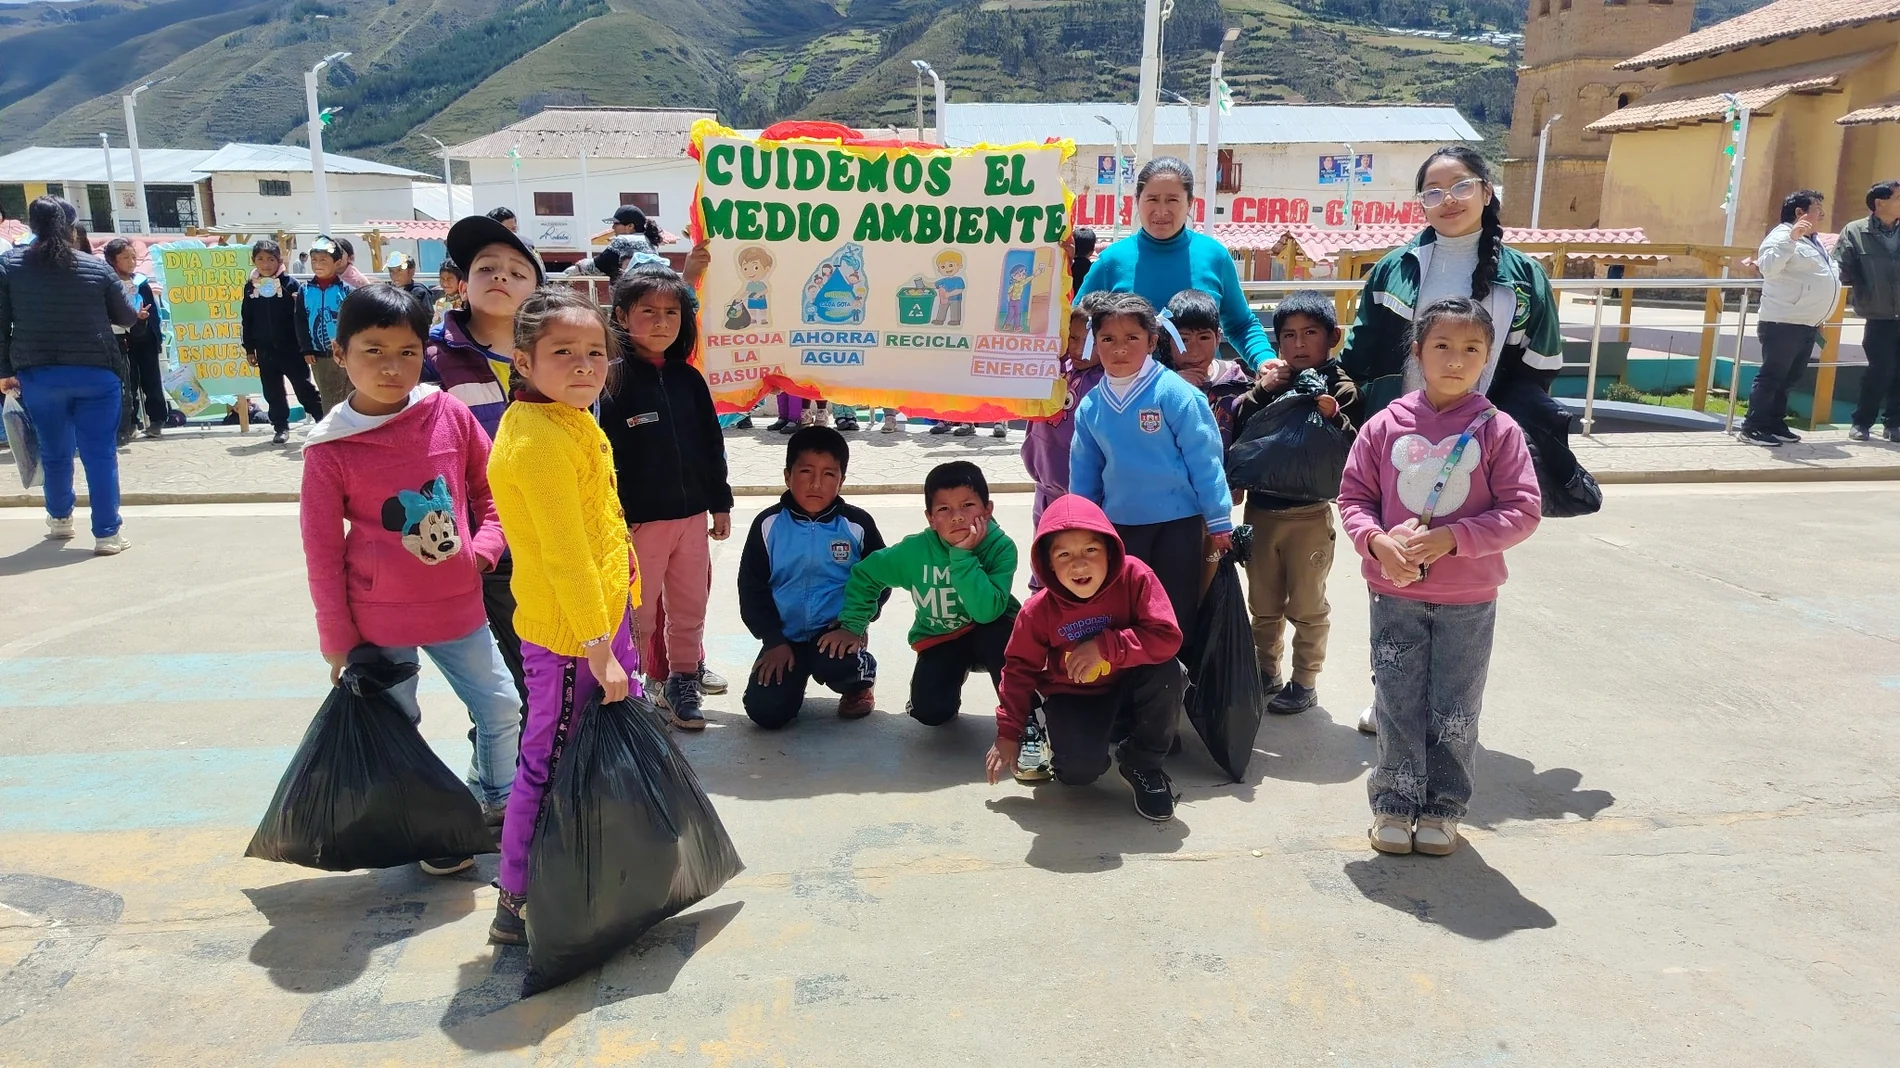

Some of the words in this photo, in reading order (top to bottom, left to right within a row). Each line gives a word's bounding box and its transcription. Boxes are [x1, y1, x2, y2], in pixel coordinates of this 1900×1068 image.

[705, 143, 951, 197] CUIDEMOS
[984, 153, 1035, 196] EL
[1232, 197, 1309, 223] CIRO
[701, 196, 840, 242] MEDIO
[852, 201, 1066, 244] AMBIENTE
[165, 251, 202, 270] DIA
[210, 250, 238, 269] DE
[184, 268, 248, 286] TIERR
[168, 285, 244, 304] CUIDEM
[208, 301, 238, 320] EL
[173, 323, 243, 342] PLANE
[707, 332, 784, 348] RECOJA
[791, 330, 877, 346] AHORRA
[885, 334, 971, 350] RECICLA
[976, 335, 1059, 353] AHORRA
[734, 350, 758, 363] LA
[803, 350, 861, 365] AGUA
[708, 365, 784, 386] BASURA
[973, 359, 1059, 378] ENERGÍA
[912, 584, 963, 618] ME
[1057, 613, 1113, 637] Chimpanzini
